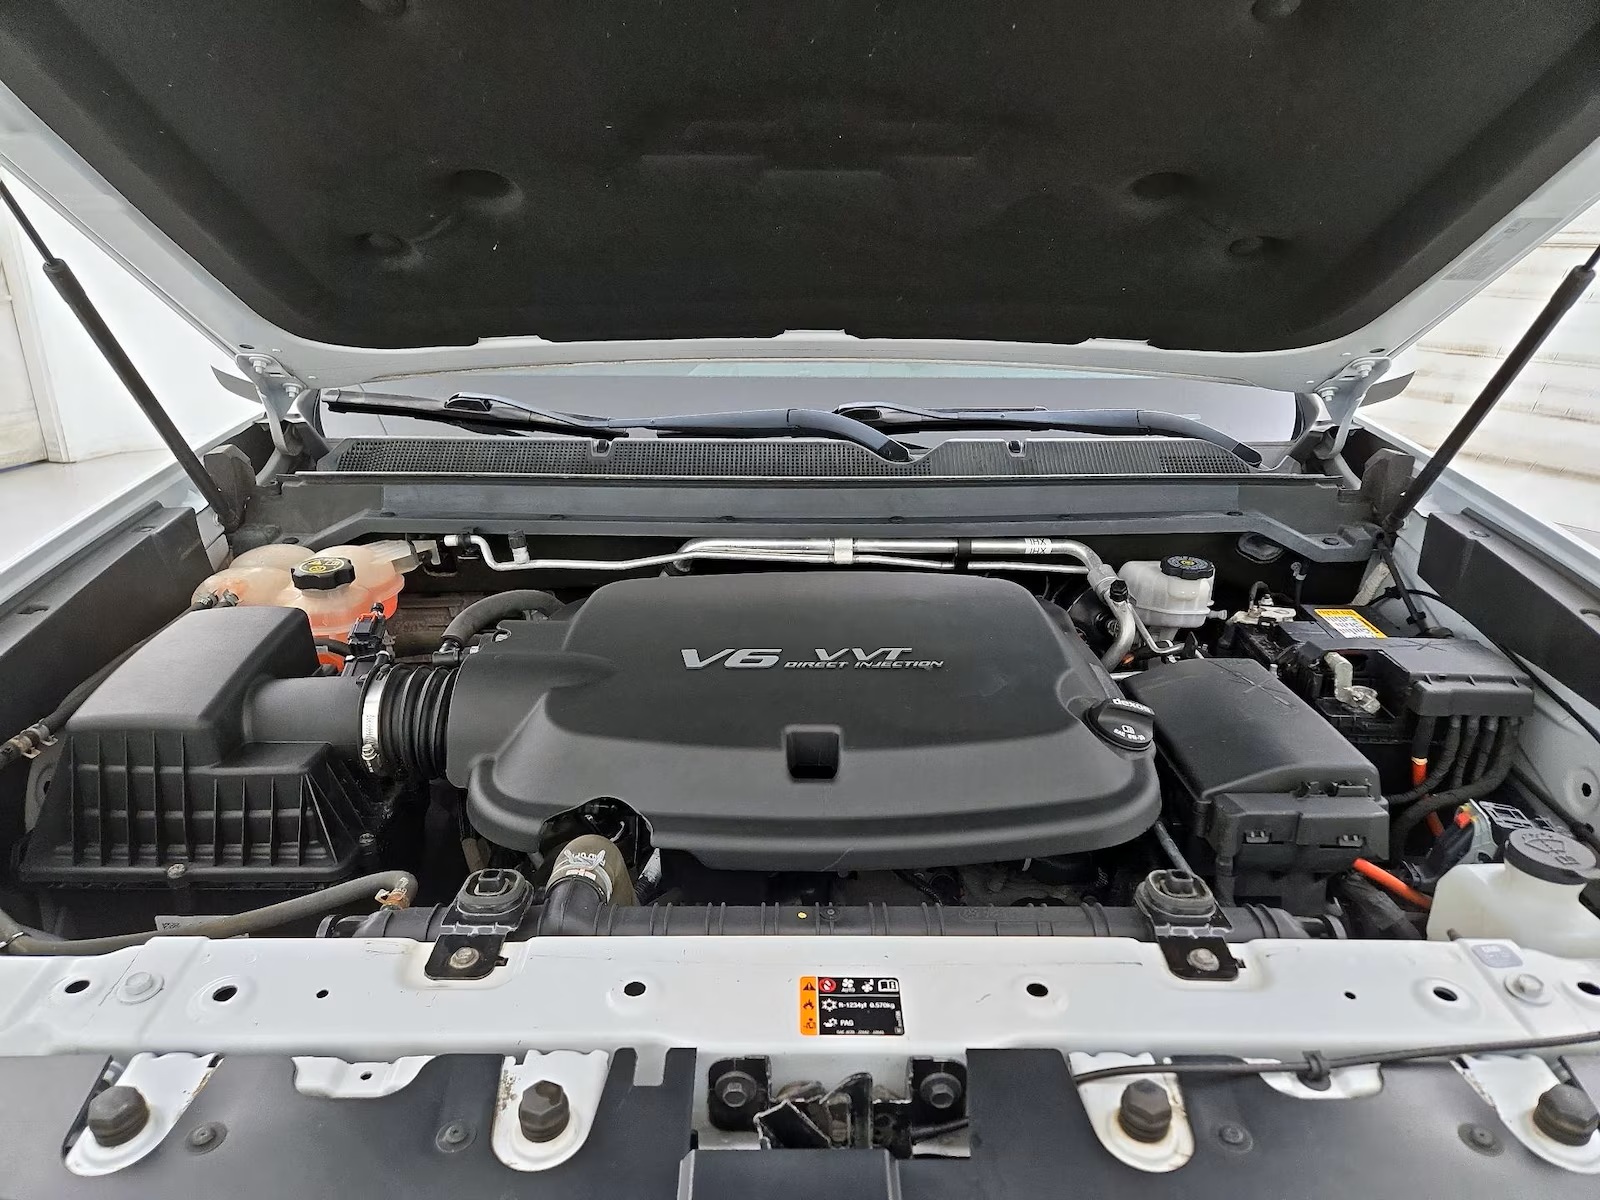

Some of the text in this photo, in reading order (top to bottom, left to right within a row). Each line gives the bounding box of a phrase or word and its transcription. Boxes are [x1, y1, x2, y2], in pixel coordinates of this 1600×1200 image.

[681, 647, 912, 669] V6 VVT
[784, 660, 944, 669] DIRECT INJECTION
[840, 1019, 854, 1027] PAG
